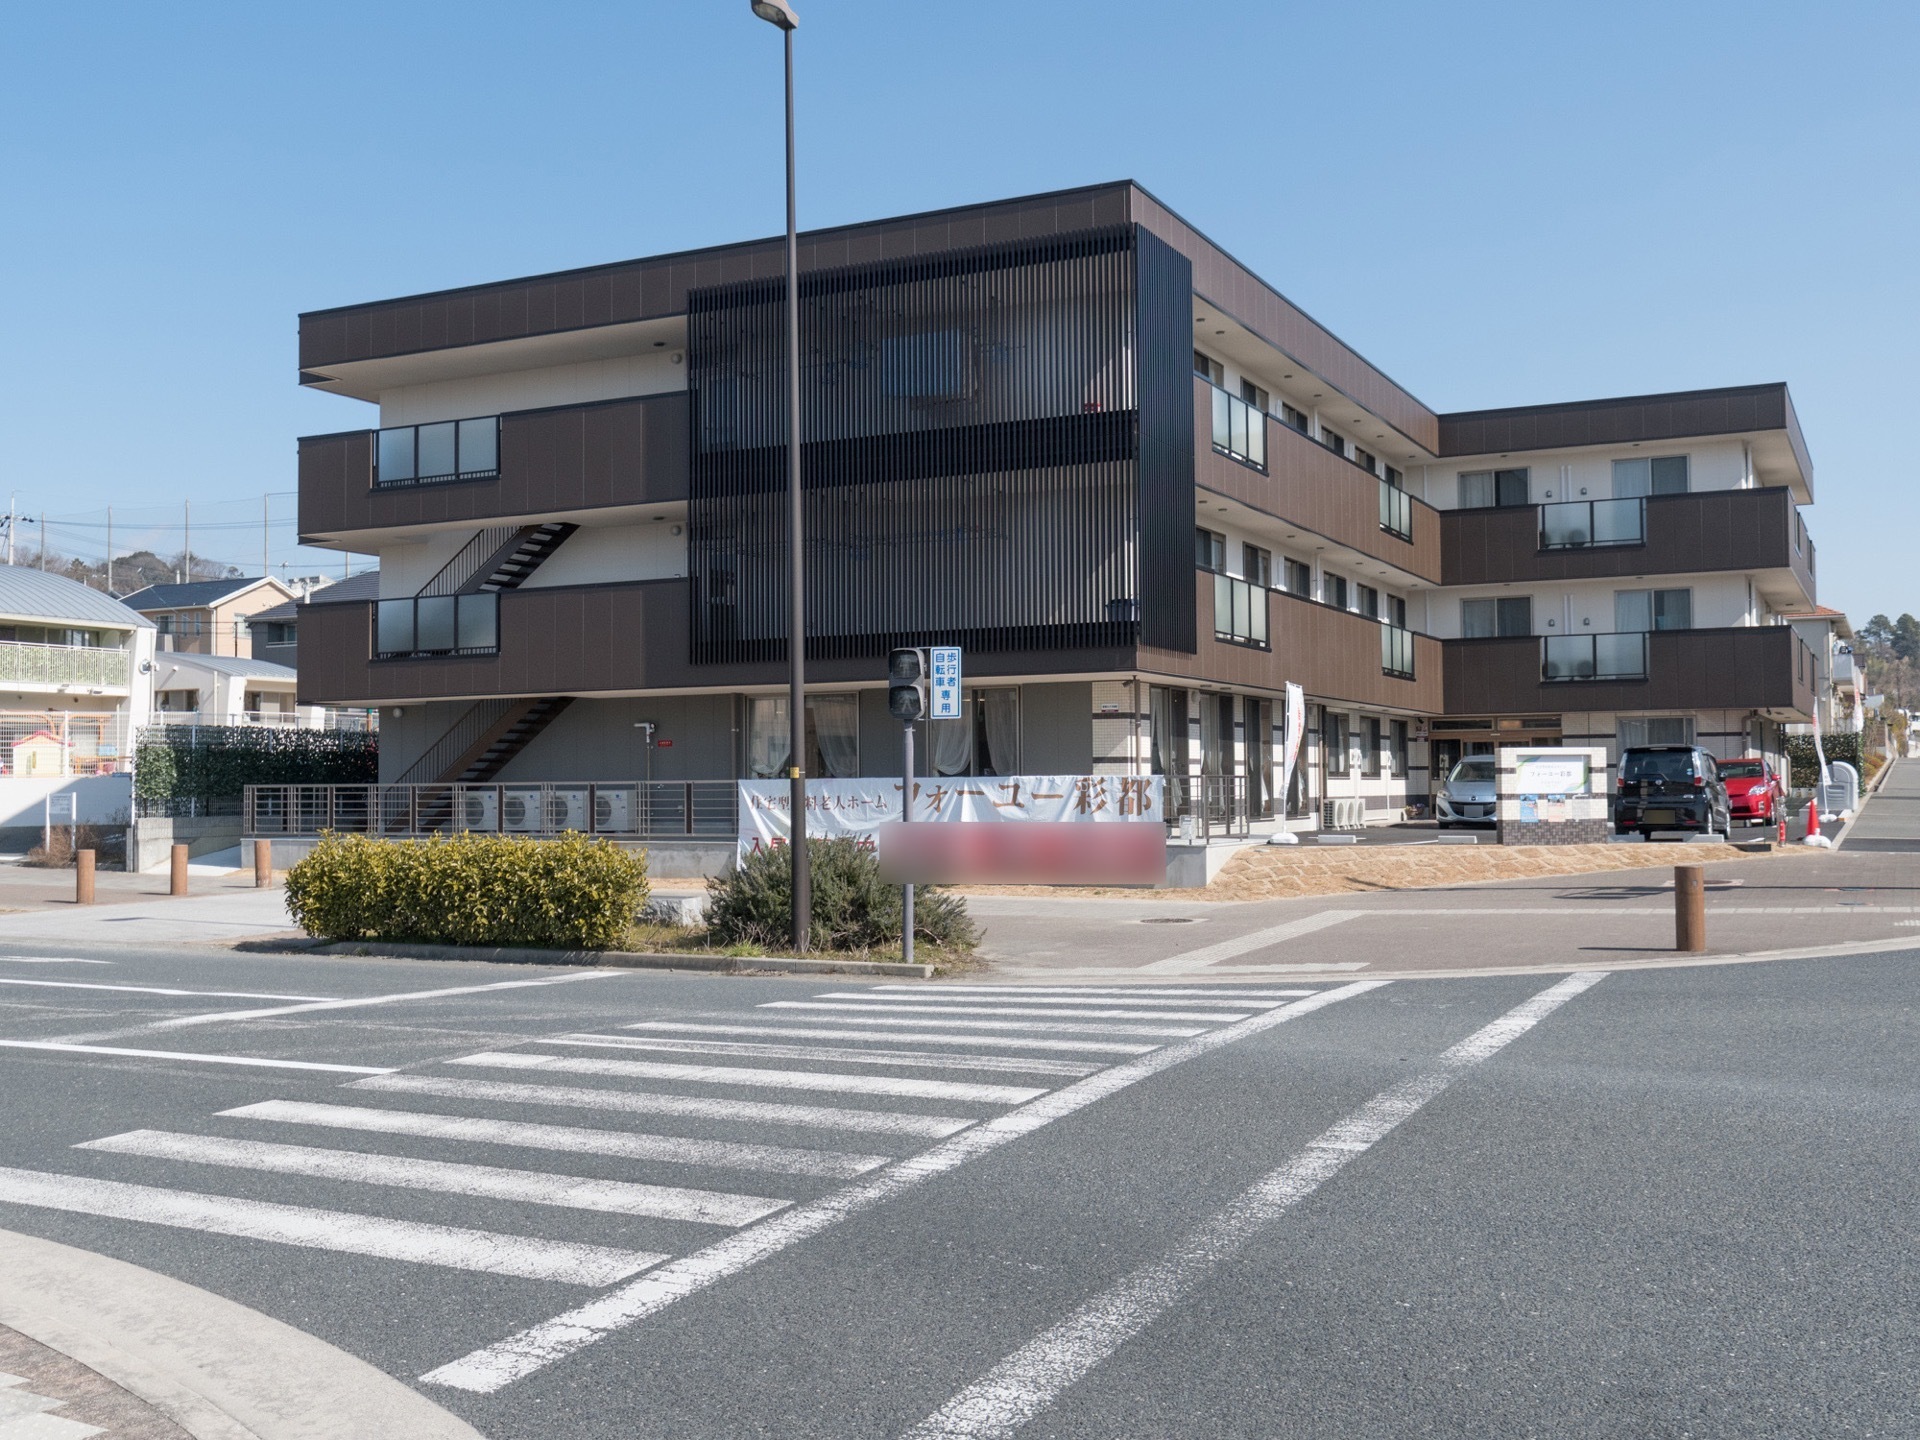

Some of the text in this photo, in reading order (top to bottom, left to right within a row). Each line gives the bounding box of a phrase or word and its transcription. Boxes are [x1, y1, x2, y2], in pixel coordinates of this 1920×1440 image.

[935, 652, 946, 687] 自転車
[947, 652, 957, 686] 歩行者
[941, 689, 951, 713] 専用
[750, 776, 1152, 816] 住宅型料老人ホーム フォーユー彩都
